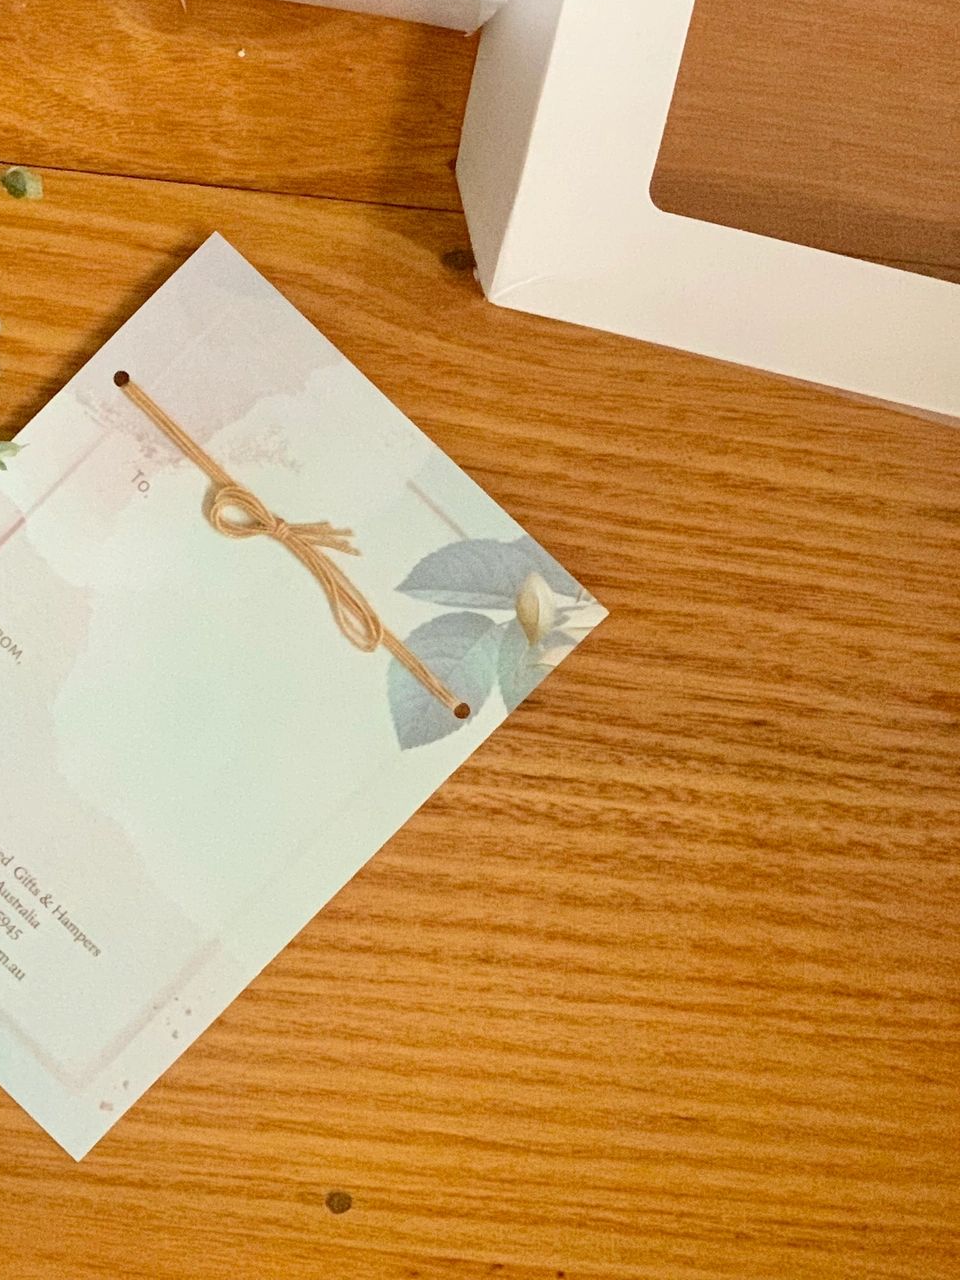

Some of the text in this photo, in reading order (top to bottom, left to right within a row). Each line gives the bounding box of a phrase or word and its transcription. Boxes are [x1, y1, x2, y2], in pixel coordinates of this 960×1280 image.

[13, 866, 41, 897] Gifts
[39, 893, 53, 908] &
[52, 904, 102, 958] Hampers
